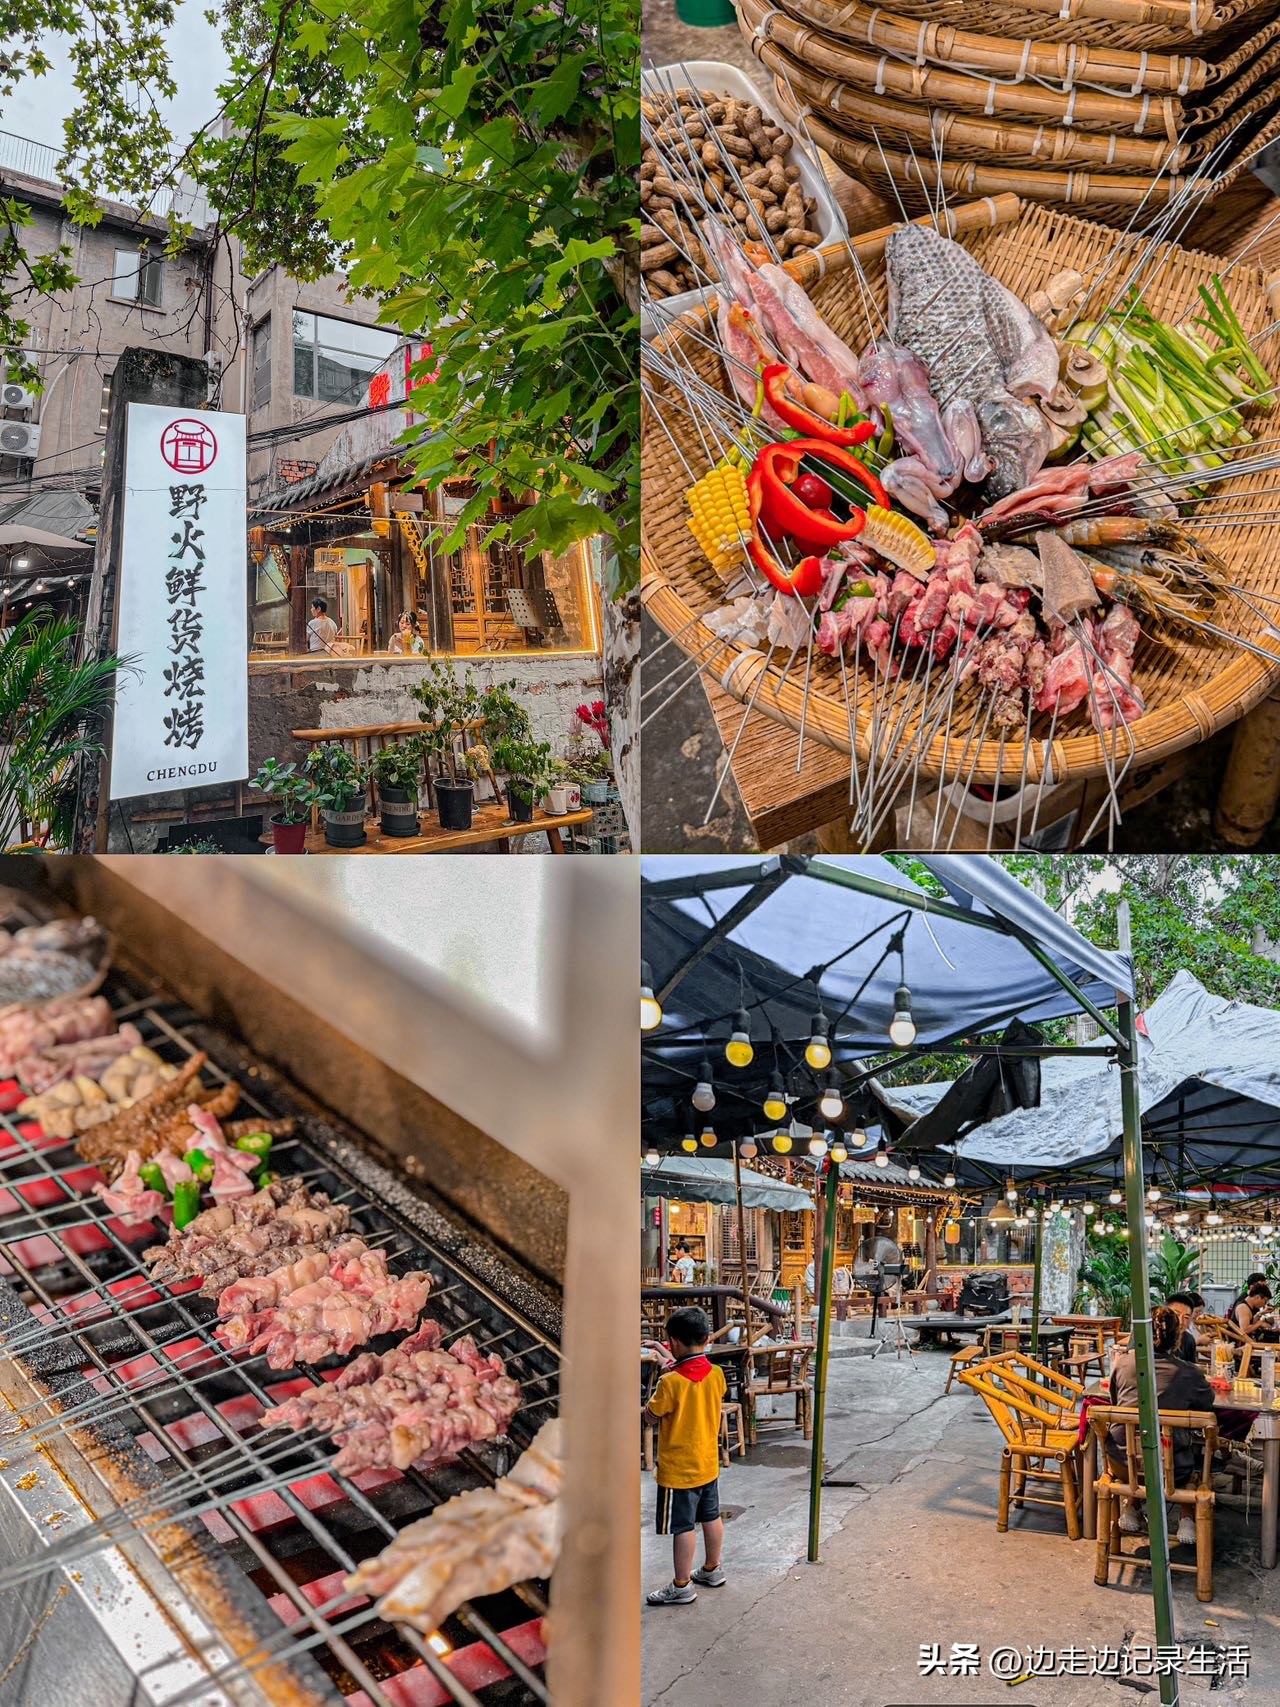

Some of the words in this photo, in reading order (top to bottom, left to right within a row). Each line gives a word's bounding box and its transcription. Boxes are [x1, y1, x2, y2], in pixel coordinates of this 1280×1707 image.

[163, 484, 208, 750] 野火鲜货烧烤
[146, 761, 218, 782] CHENGDU
